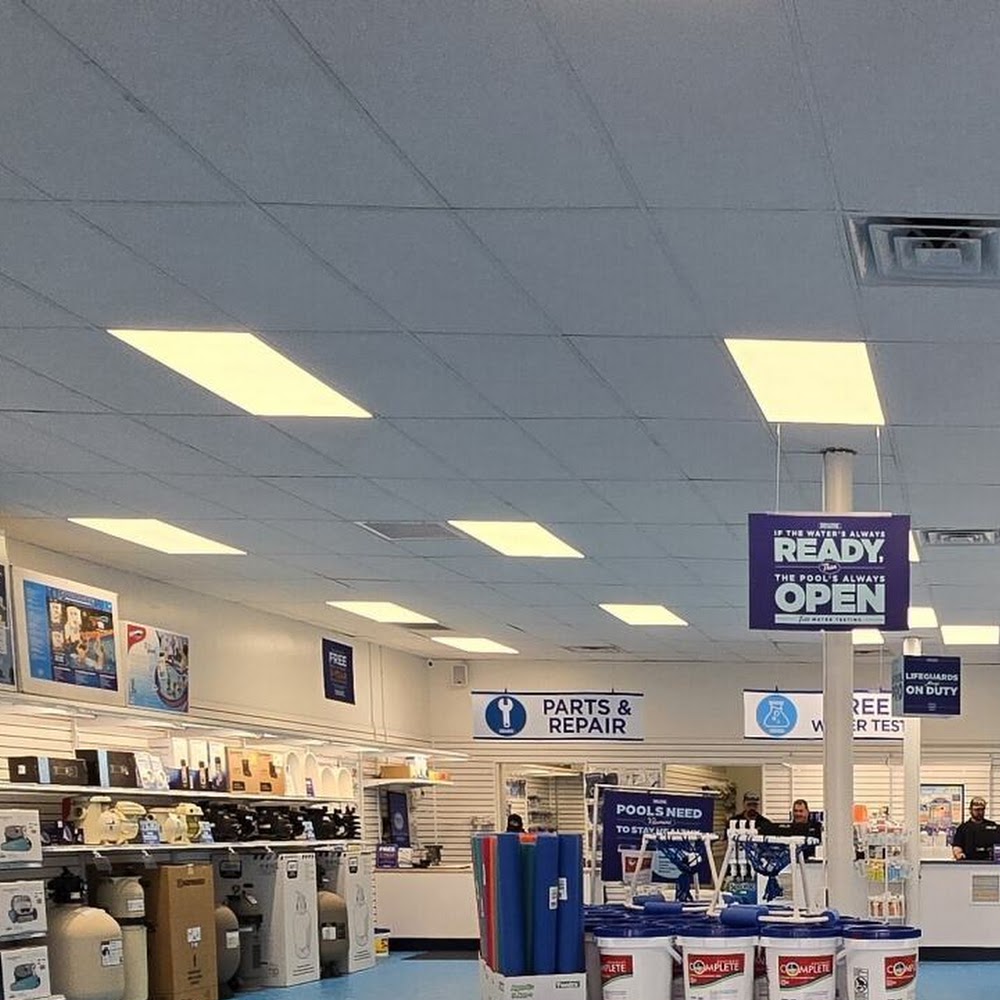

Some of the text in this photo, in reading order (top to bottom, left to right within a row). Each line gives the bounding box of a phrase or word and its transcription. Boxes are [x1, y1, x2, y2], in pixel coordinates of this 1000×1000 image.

[774, 537, 885, 563] READY,
[775, 574, 885, 583] THE POOL'S ALWAYS
[775, 582, 885, 613] OPEN
[906, 673, 958, 681] LIFEGUARDS
[906, 685, 958, 696] ON DUTY
[543, 699, 632, 715] PARTS &
[853, 698, 889, 715] REE
[550, 717, 626, 734] REPAIR
[616, 804, 702, 819] POOLS NEED
[616, 825, 630, 833] TO
[690, 960, 739, 974] COMPLETE
[780, 962, 830, 976] COMPLETE
